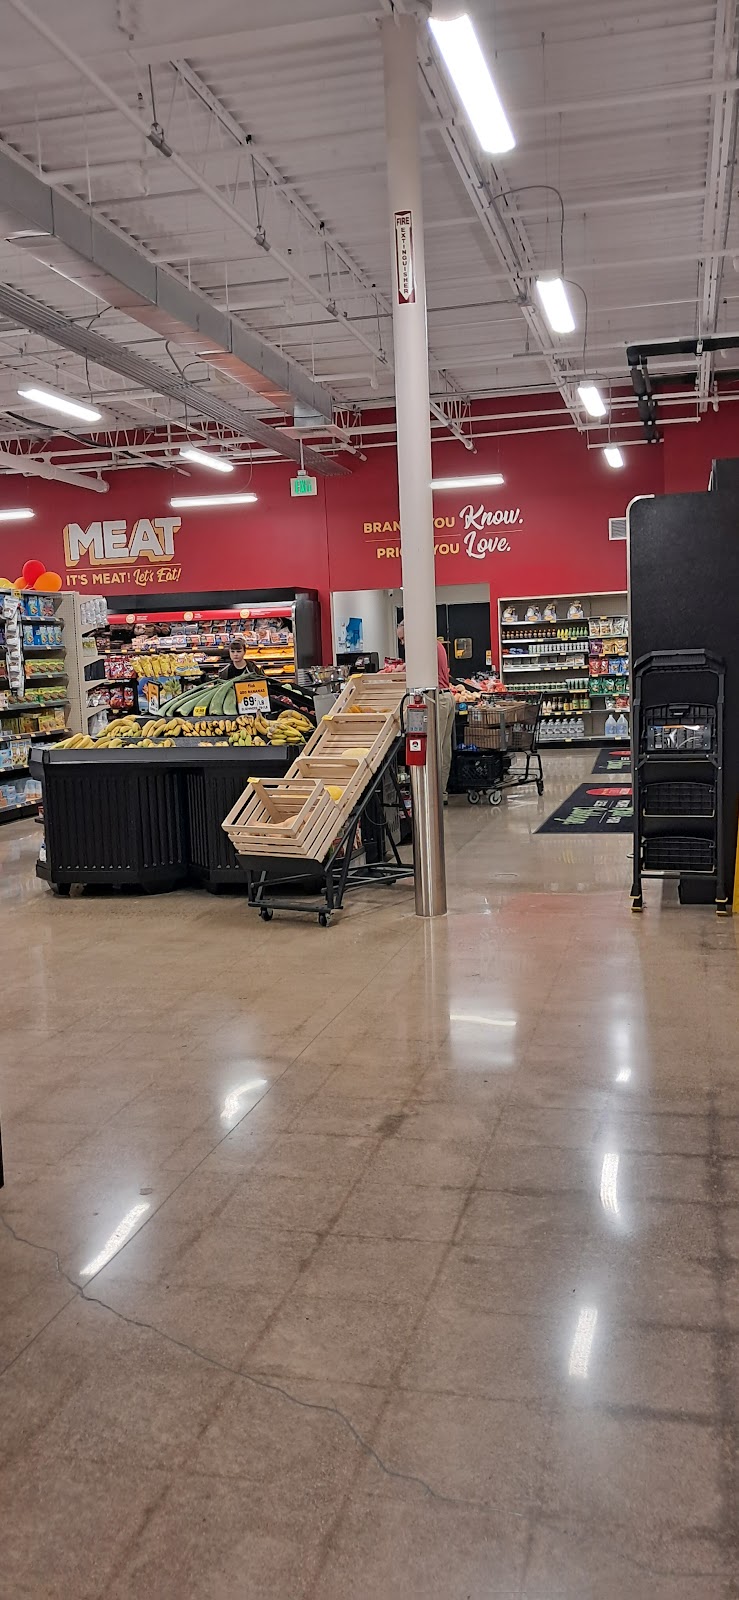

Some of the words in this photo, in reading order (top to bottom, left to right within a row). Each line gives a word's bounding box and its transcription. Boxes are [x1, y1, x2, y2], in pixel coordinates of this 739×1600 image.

[396, 216, 410, 227] FIRE
[400, 227, 409, 294] EXTINGUISHER
[433, 516, 456, 529] OU
[459, 504, 524, 531] Know.
[63, 516, 182, 567] MEAT
[463, 530, 512, 560] Love.
[66, 574, 89, 586] IT'S
[92, 572, 131, 585] MEAT!
[132, 568, 155, 587] Let's
[156, 567, 182, 583] Eat!
